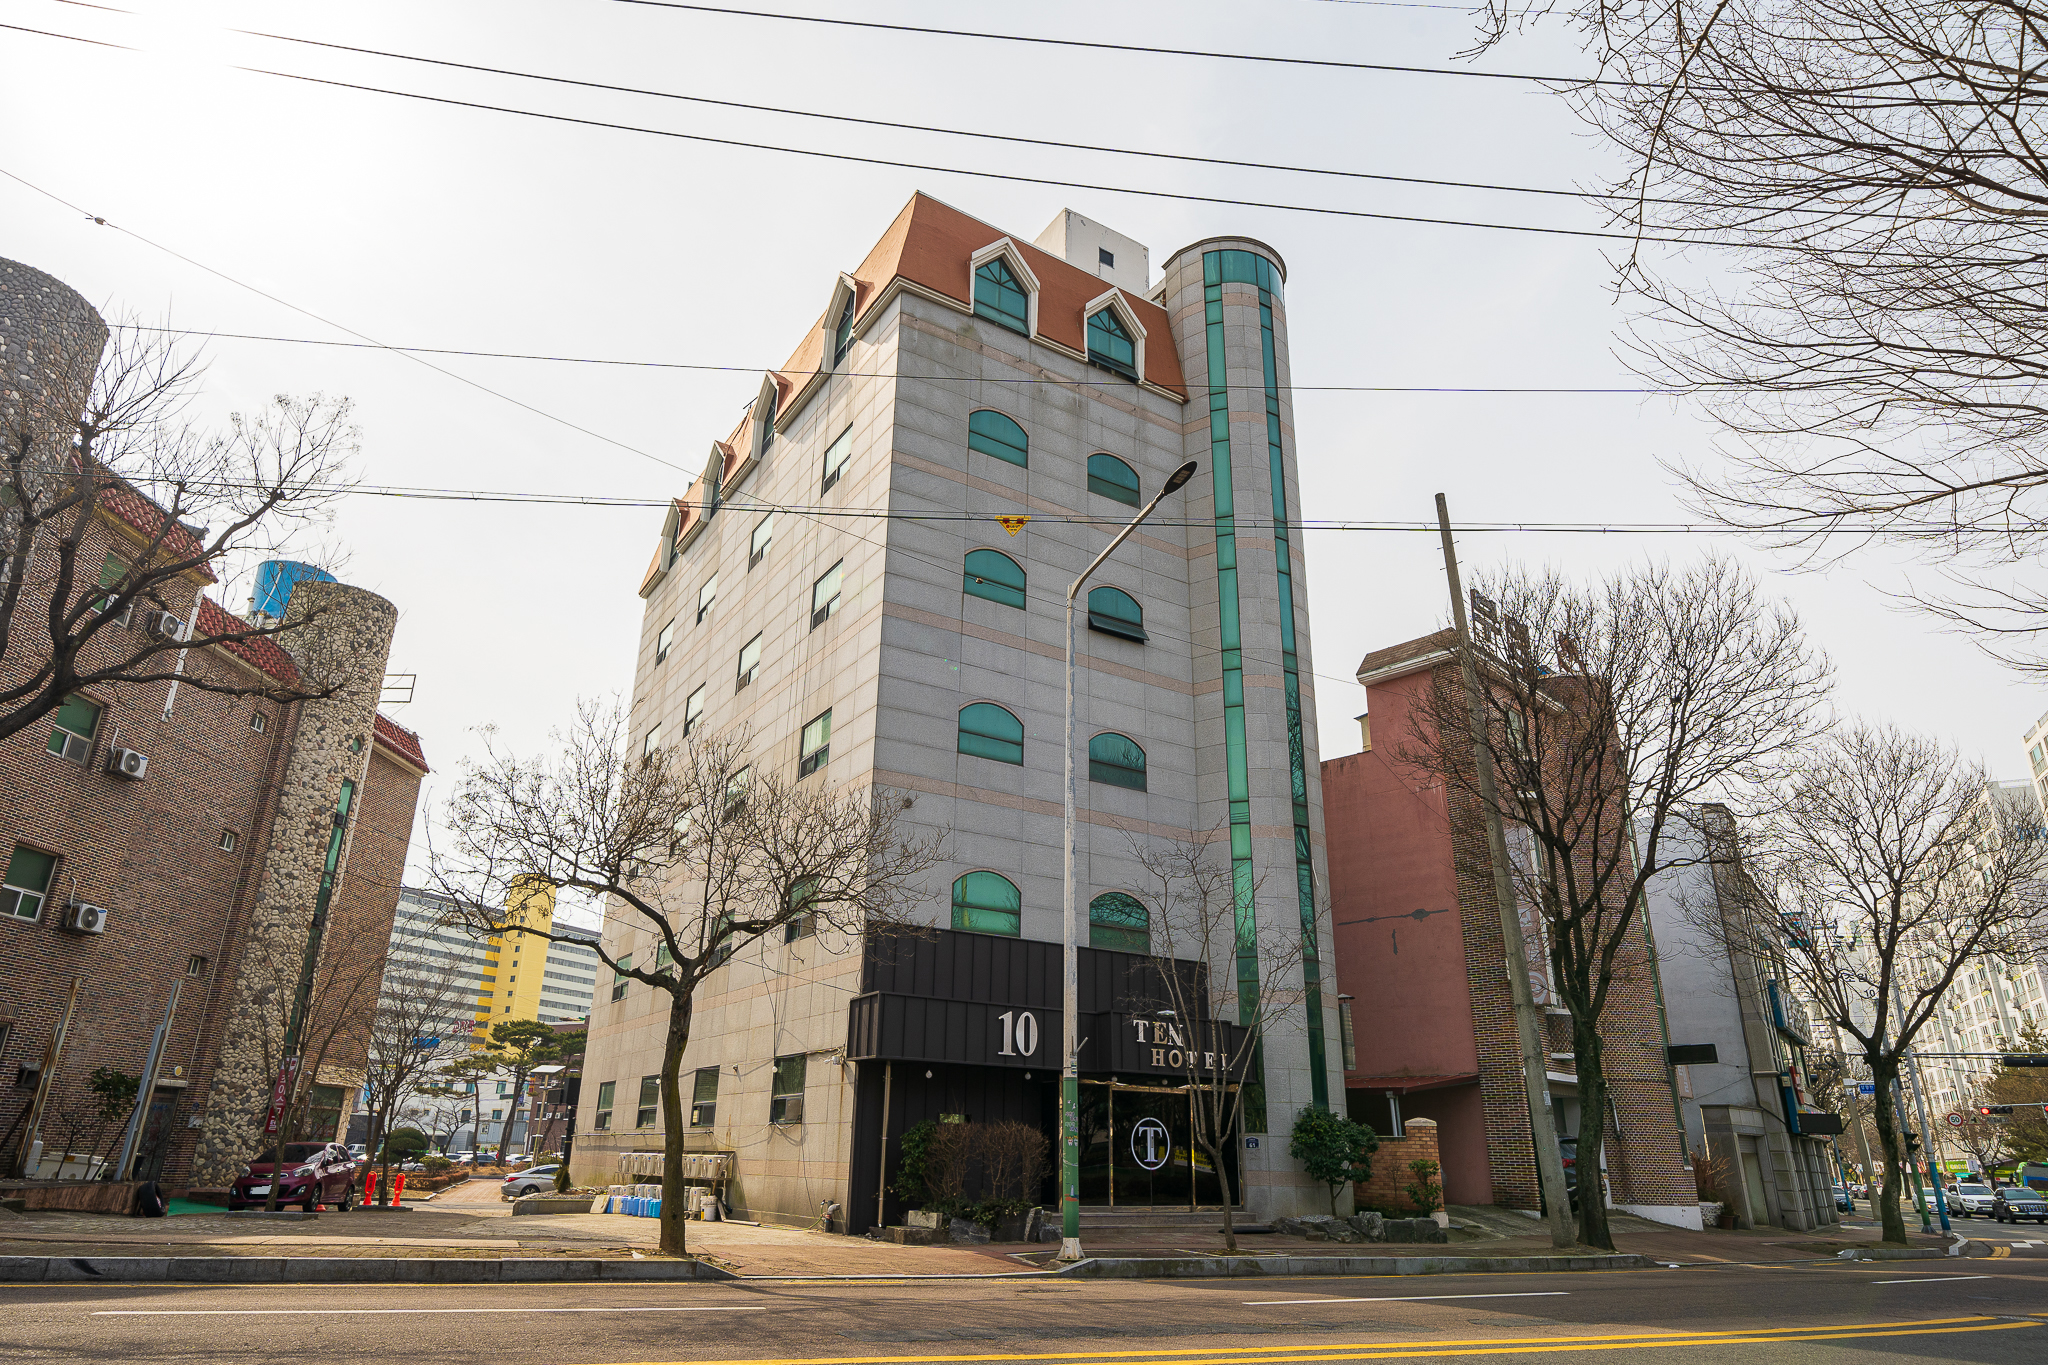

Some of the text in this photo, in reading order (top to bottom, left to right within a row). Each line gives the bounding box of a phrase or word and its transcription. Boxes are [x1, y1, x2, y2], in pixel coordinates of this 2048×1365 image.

[998, 1011, 1038, 1057] 10
[1133, 1019, 1183, 1047] TEN
[1139, 1127, 1162, 1162] T
